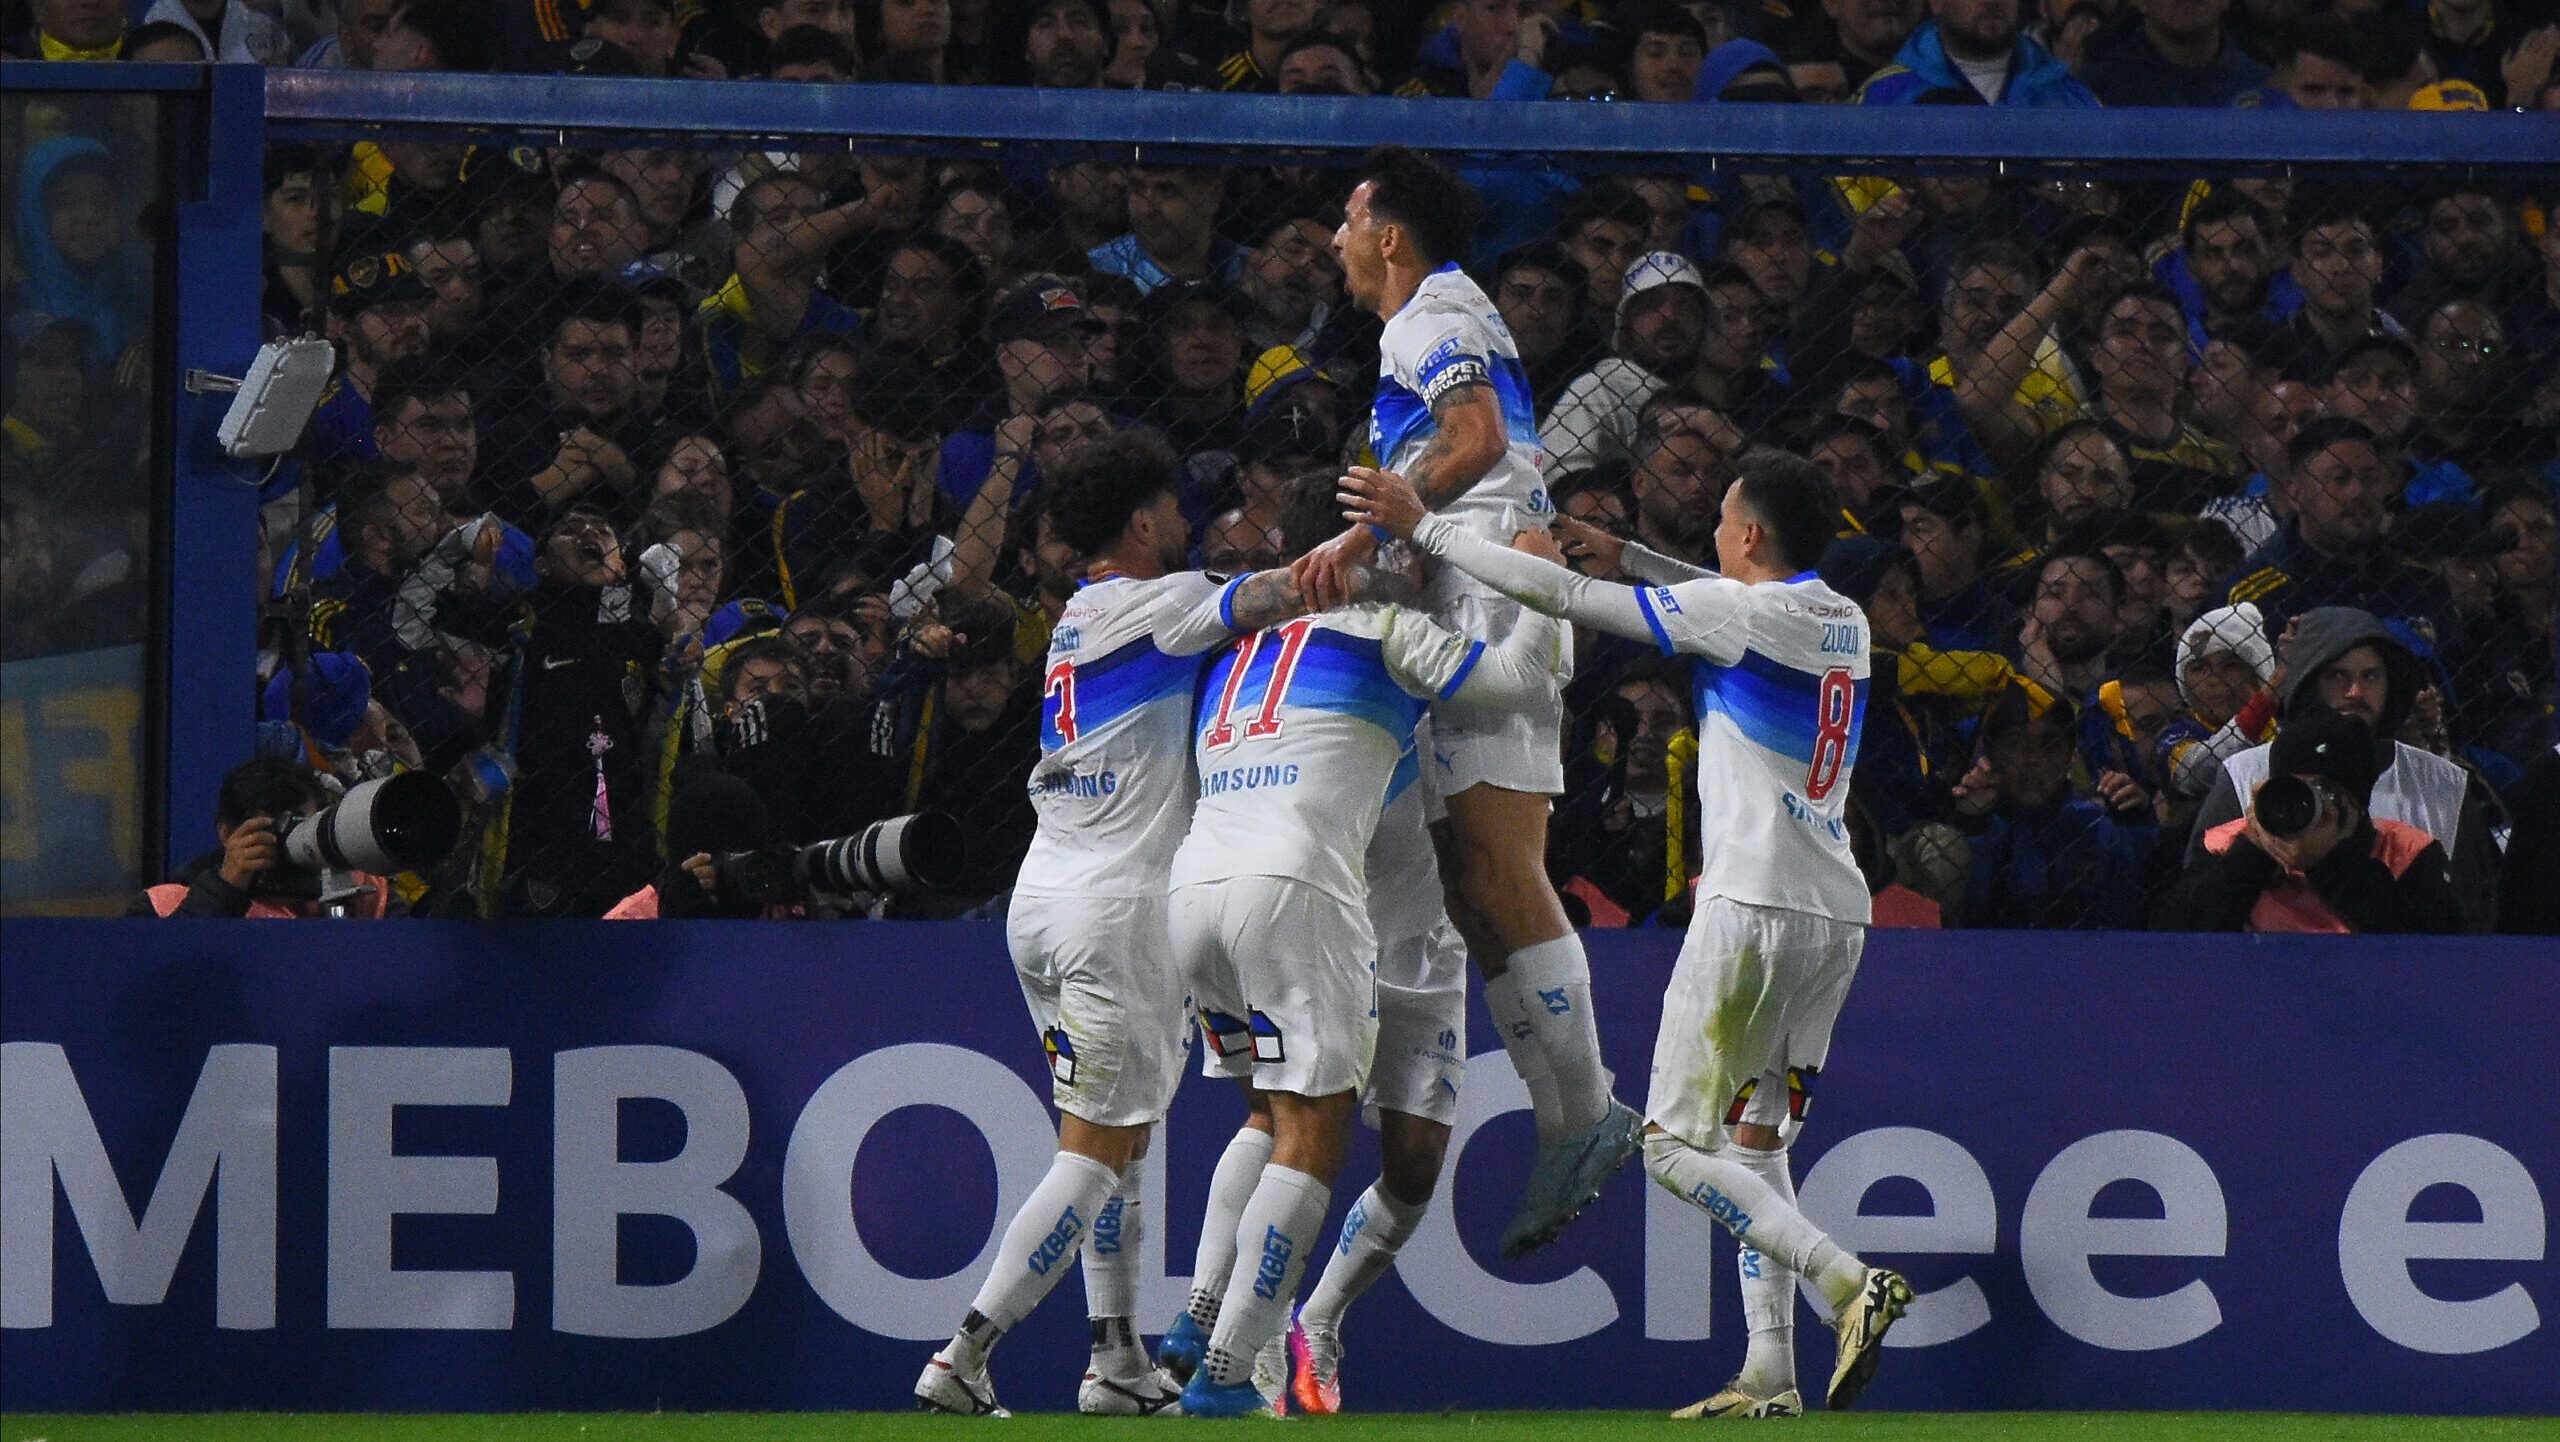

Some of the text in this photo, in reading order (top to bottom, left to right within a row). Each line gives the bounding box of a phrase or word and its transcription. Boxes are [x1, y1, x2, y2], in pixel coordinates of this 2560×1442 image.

[1204, 614, 1320, 754] 11
[1821, 623, 1859, 655] ZUQUI
[1805, 665, 1855, 806] 8
[1028, 1204, 1083, 1276] 1XBET
[1253, 1225, 1292, 1302] 1XBET
[2338, 1132, 2546, 1355] e
